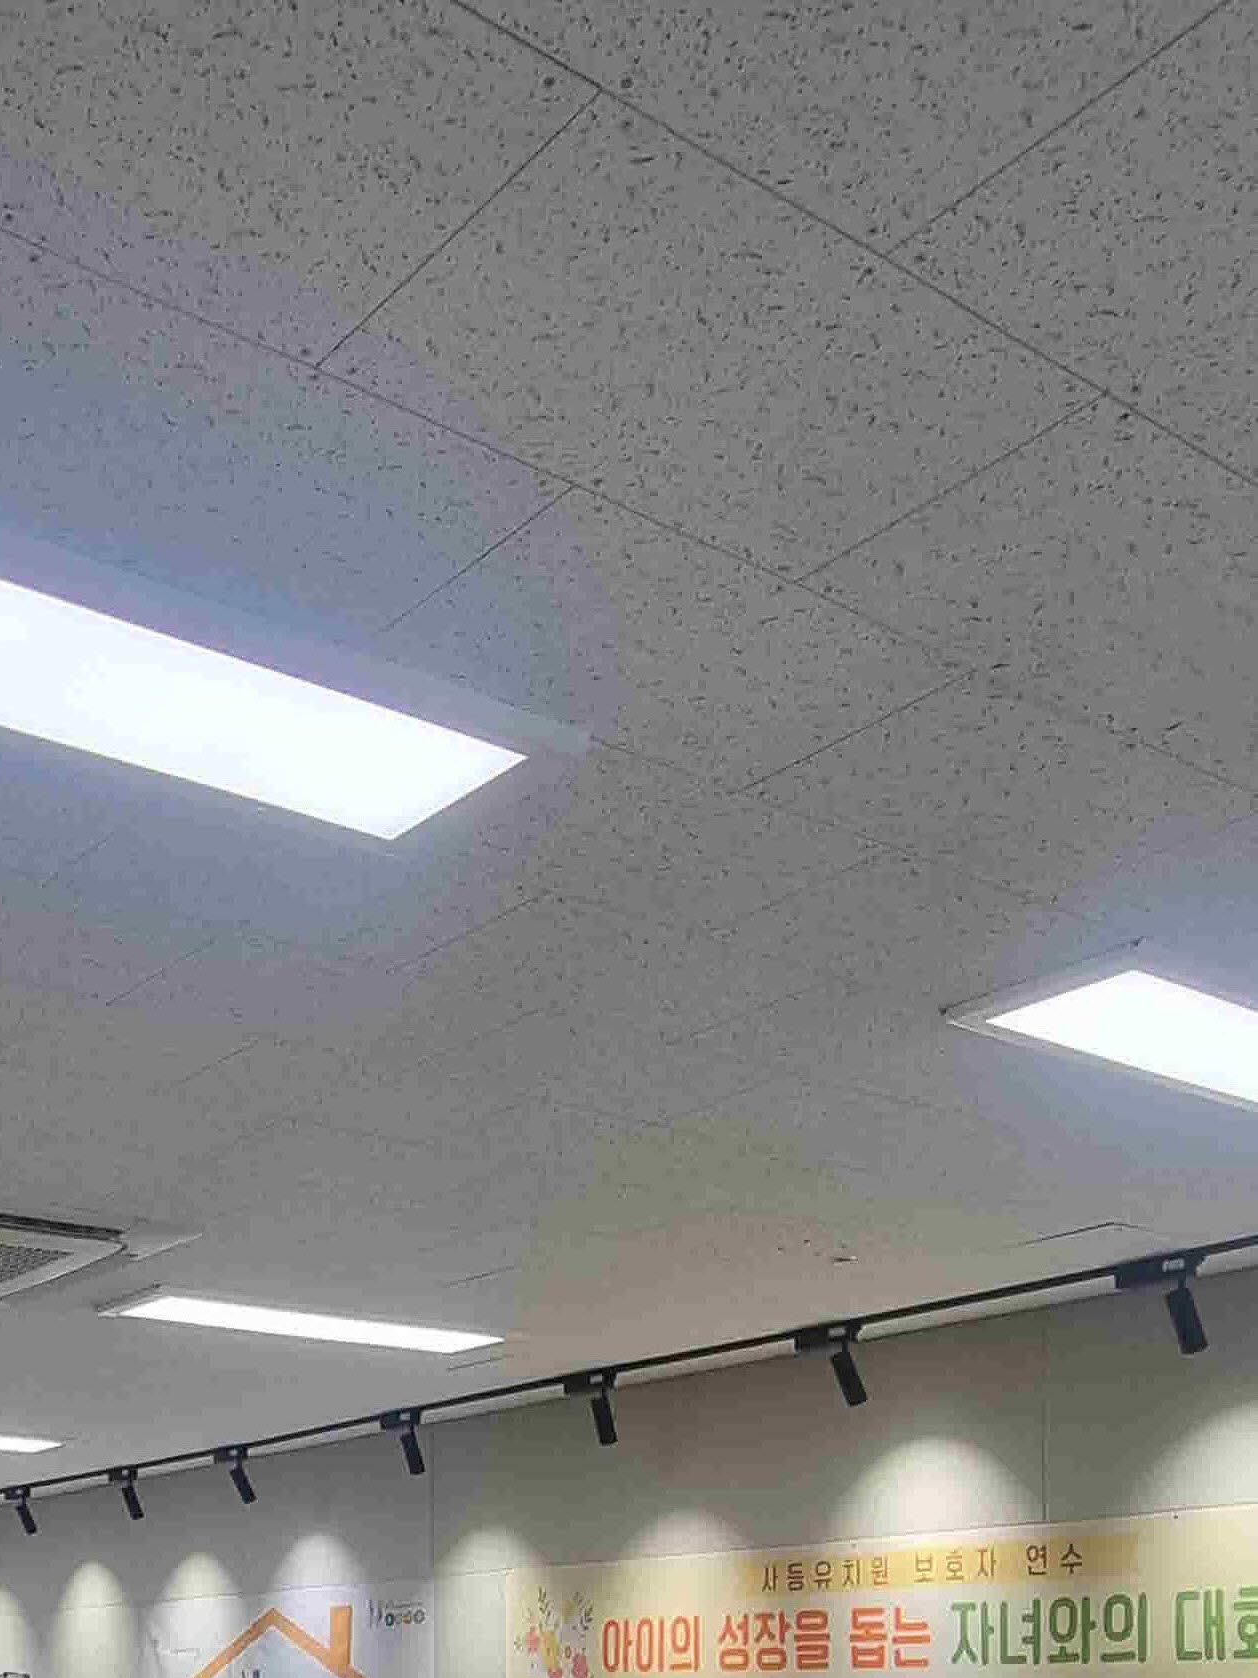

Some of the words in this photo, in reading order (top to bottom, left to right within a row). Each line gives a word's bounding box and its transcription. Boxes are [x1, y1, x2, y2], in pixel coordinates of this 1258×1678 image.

[762, 1555, 890, 1593] 사등유치원
[913, 1544, 996, 1583] 보호자
[1026, 1543, 1083, 1576] 연수
[602, 1616, 701, 1672] 아이의
[718, 1609, 831, 1671] 성장을
[849, 1606, 931, 1669] 돕는
[950, 1592, 1147, 1665] 자녀와의
